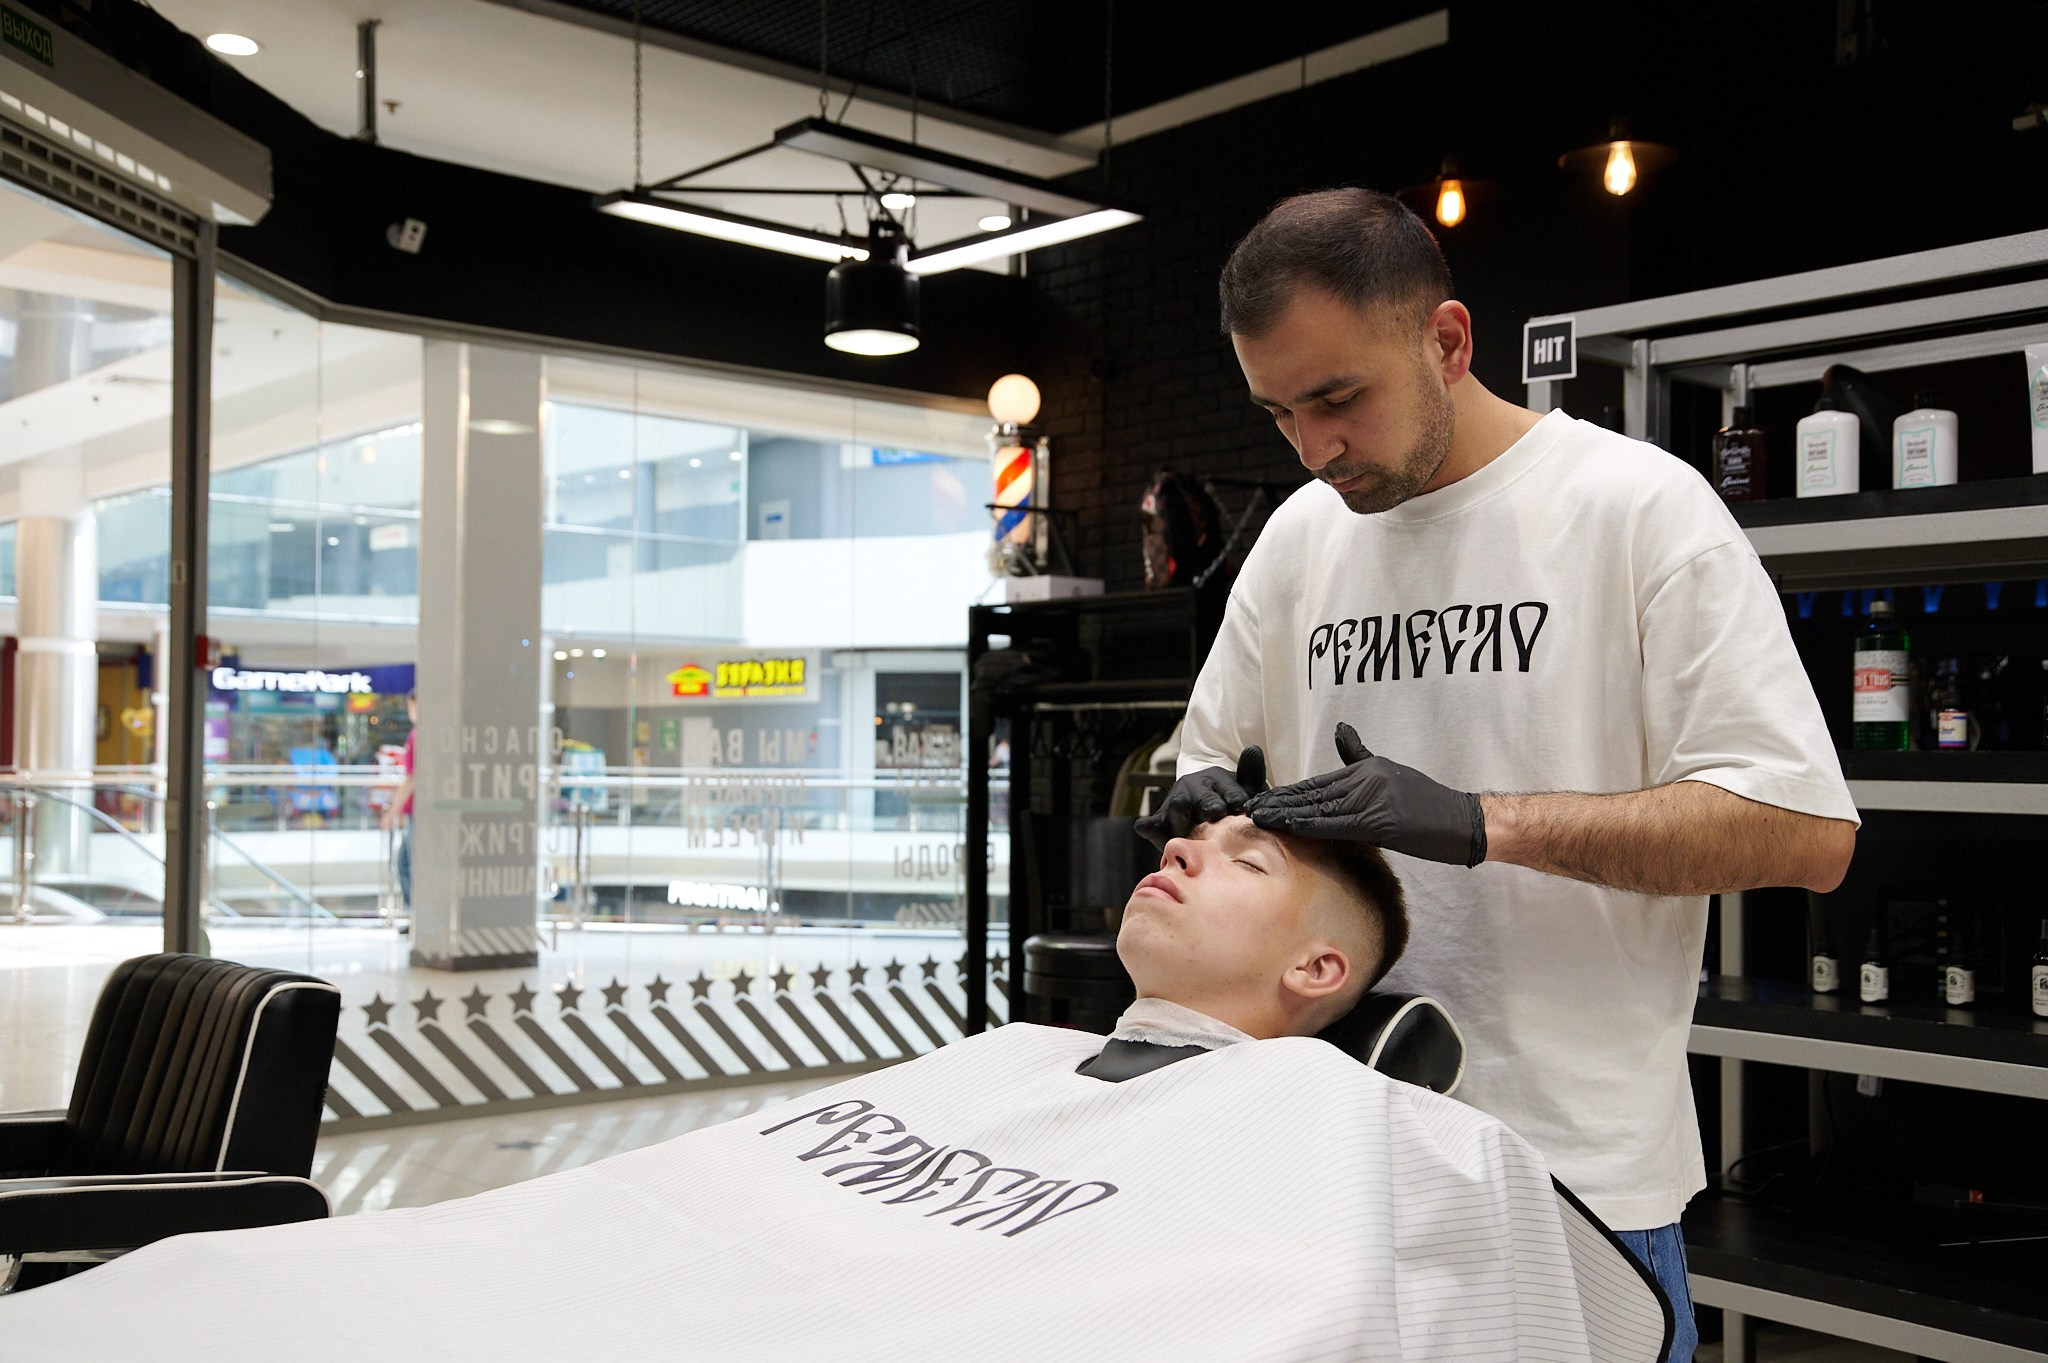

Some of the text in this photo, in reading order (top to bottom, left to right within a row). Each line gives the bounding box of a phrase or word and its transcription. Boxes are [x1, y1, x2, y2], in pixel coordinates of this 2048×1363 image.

[3, 11, 52, 63] ВЫХОД
[1533, 335, 1565, 365] HIT
[212, 667, 373, 694] GamePark
